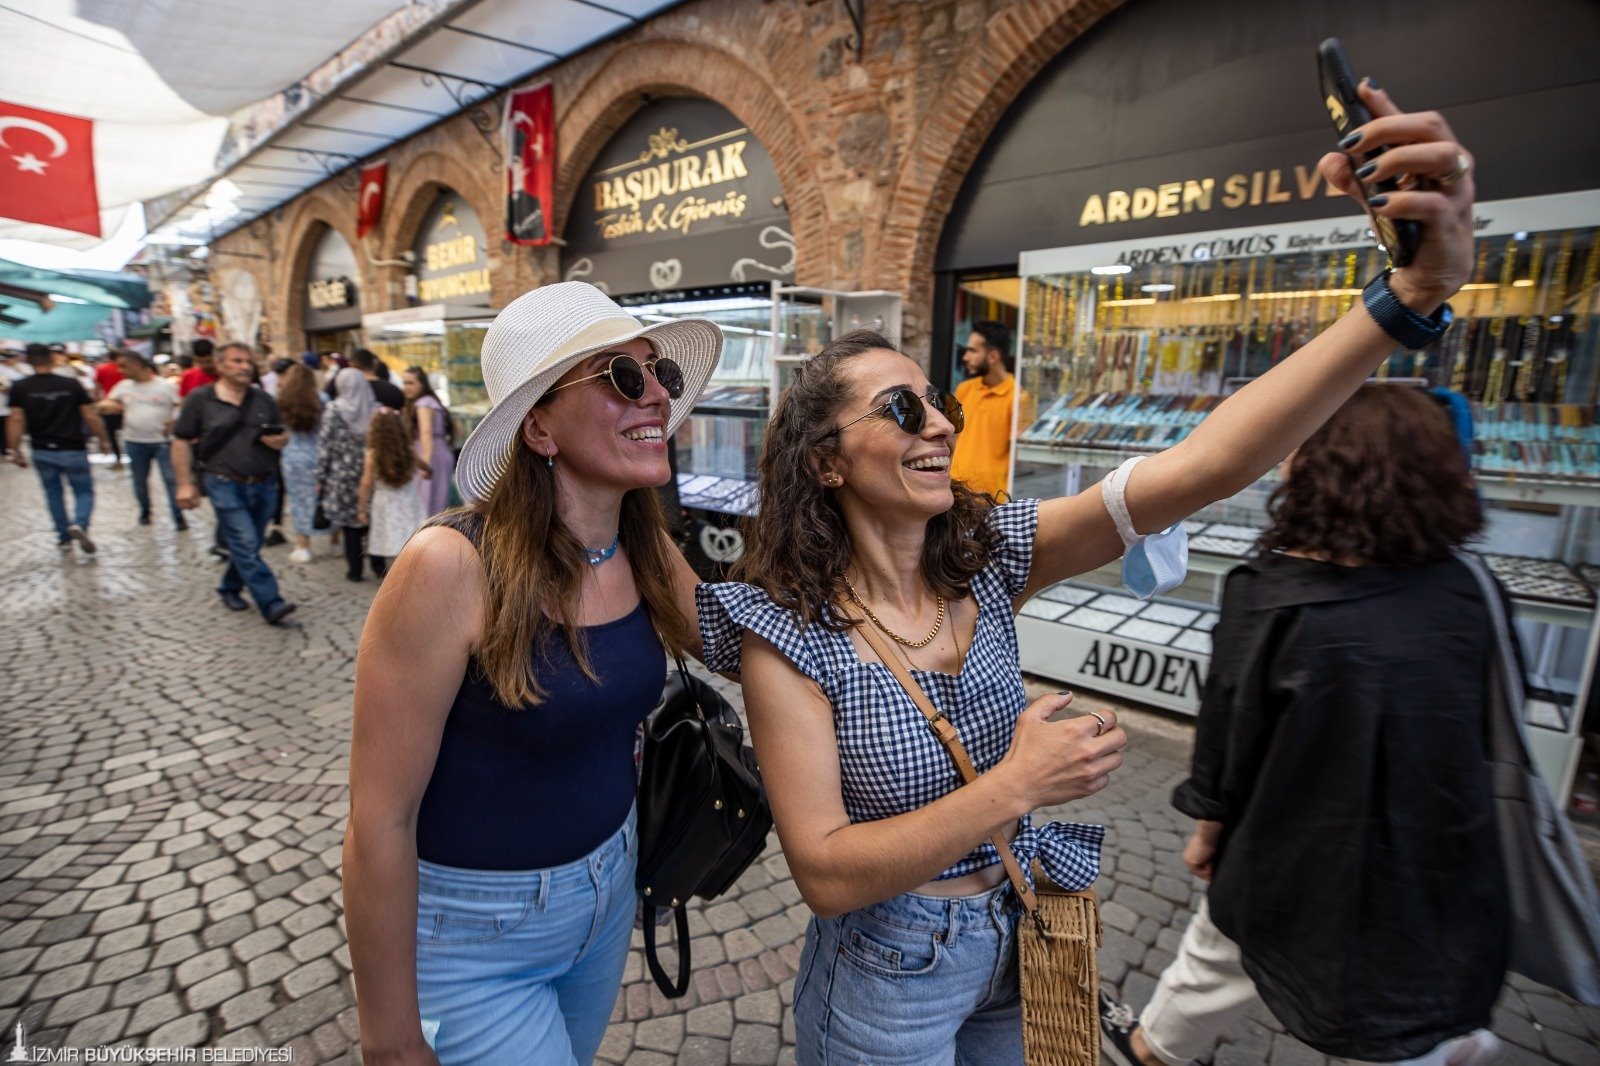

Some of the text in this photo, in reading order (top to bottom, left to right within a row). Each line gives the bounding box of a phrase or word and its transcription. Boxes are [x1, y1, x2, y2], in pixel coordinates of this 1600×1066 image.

[594, 140, 749, 212] BAŞDURAK
[1079, 165, 1350, 227] ARDEN SILV
[645, 202, 669, 234] &
[669, 191, 748, 235] Gümüş
[1115, 245, 1189, 267] ARDEN
[1078, 639, 1207, 698] ARDEN
